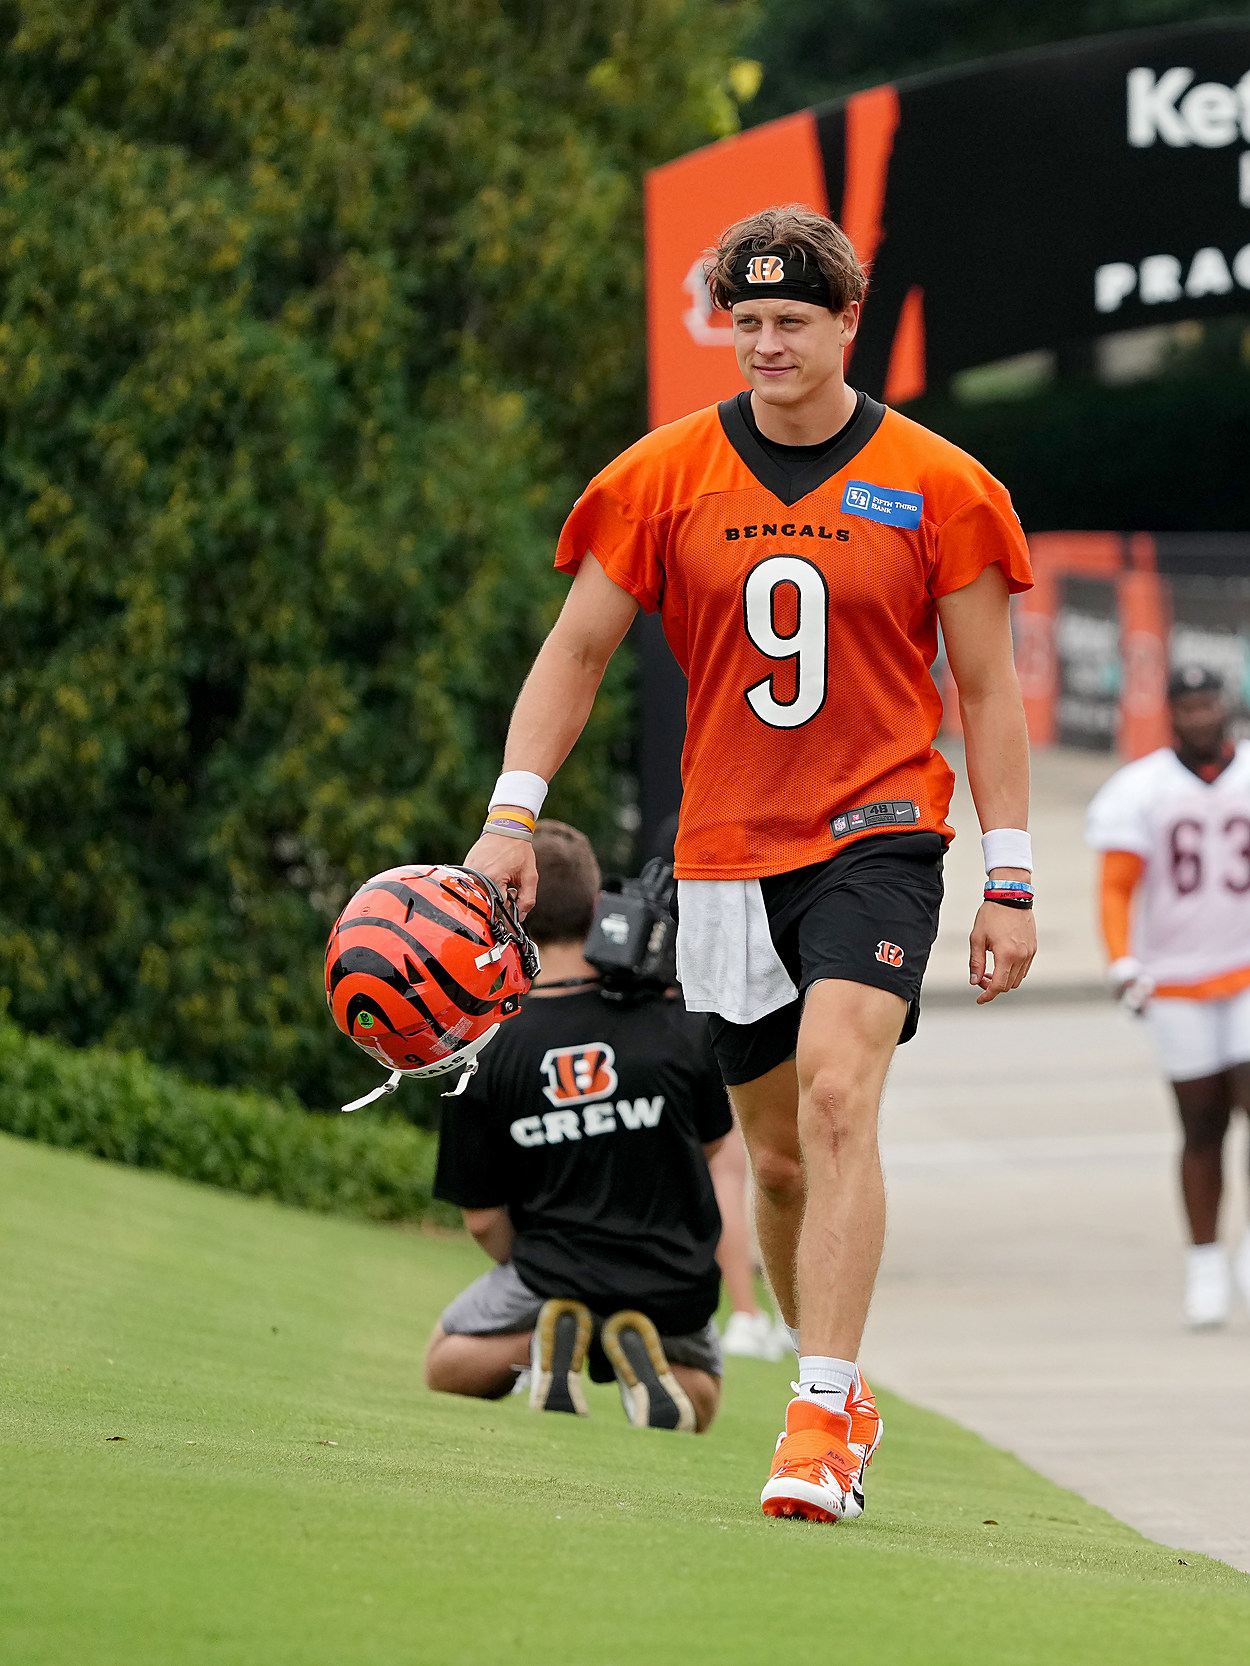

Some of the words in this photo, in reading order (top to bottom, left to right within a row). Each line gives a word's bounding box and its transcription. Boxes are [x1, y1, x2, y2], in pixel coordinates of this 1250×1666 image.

[871, 502, 892, 514] BANK
[872, 496, 893, 507] FIFTH
[894, 501, 918, 512] THIRD
[725, 523, 850, 542] BENGALS
[742, 553, 829, 731] 9
[510, 1095, 666, 1148] CREW
